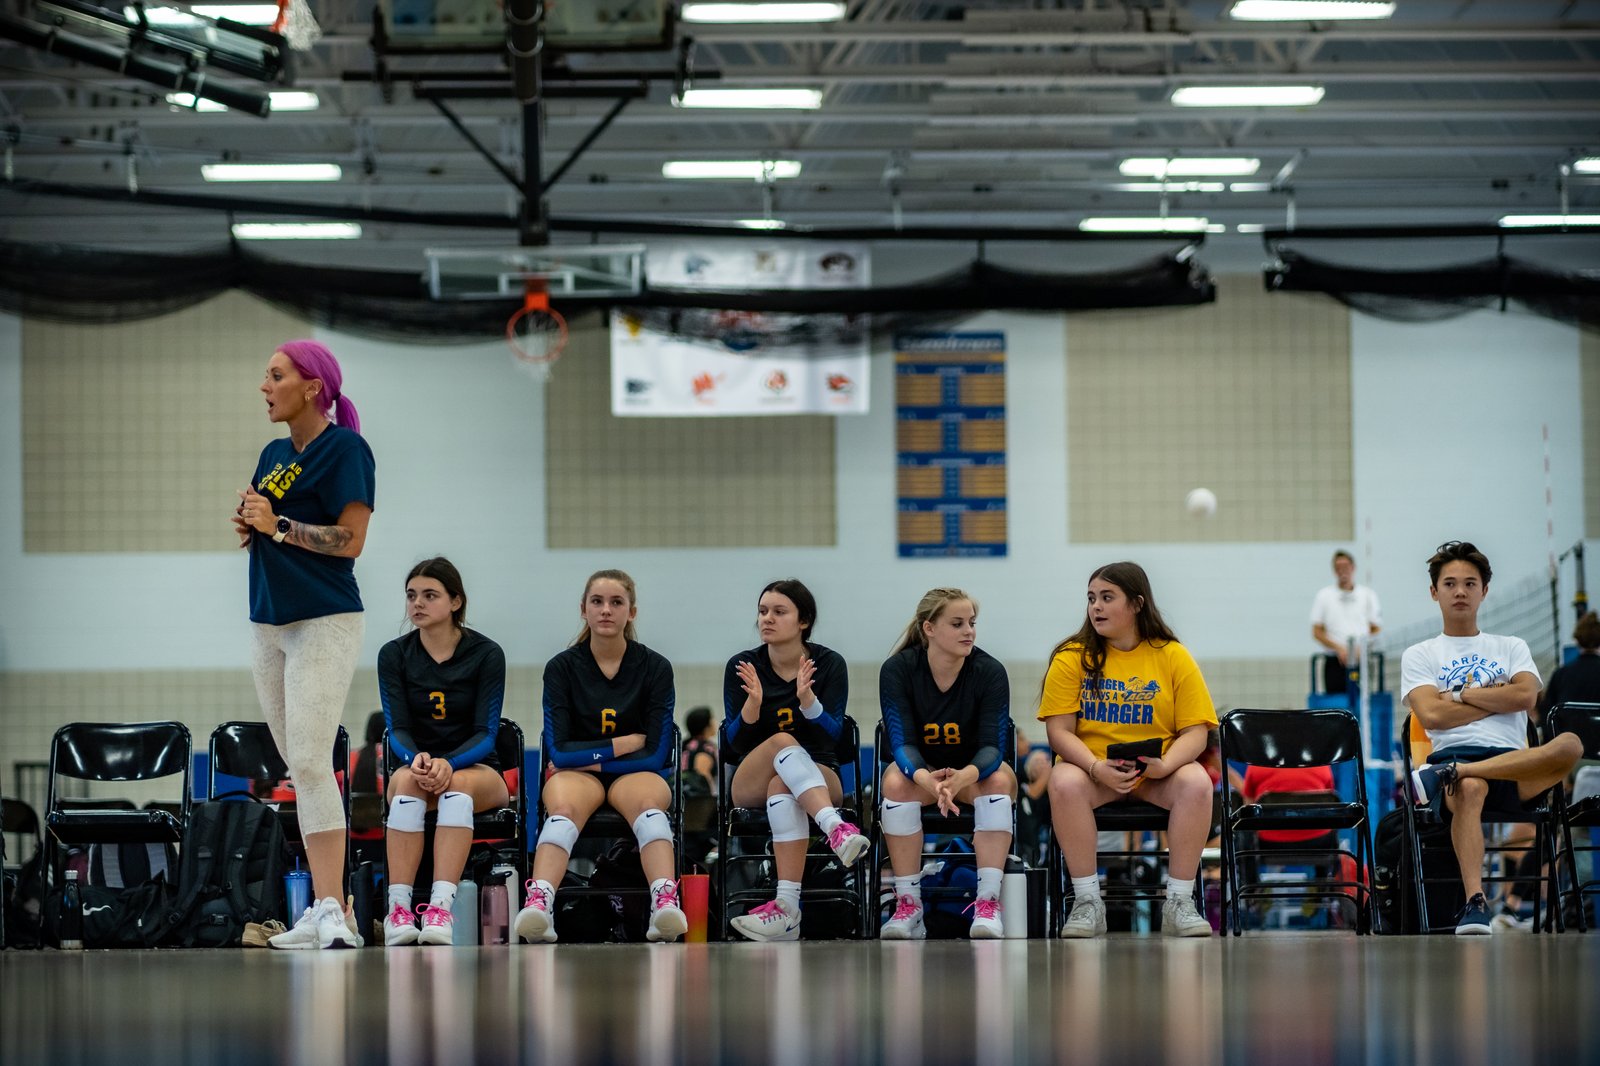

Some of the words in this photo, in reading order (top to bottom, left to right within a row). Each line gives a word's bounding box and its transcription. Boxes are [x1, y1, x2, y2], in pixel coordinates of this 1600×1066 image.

[1439, 654, 1506, 681] CHARGERS
[1081, 678, 1125, 692] CHRGER
[429, 691, 446, 720] 3
[601, 708, 617, 734] 6
[777, 707, 795, 731] 2
[923, 722, 961, 745] 28
